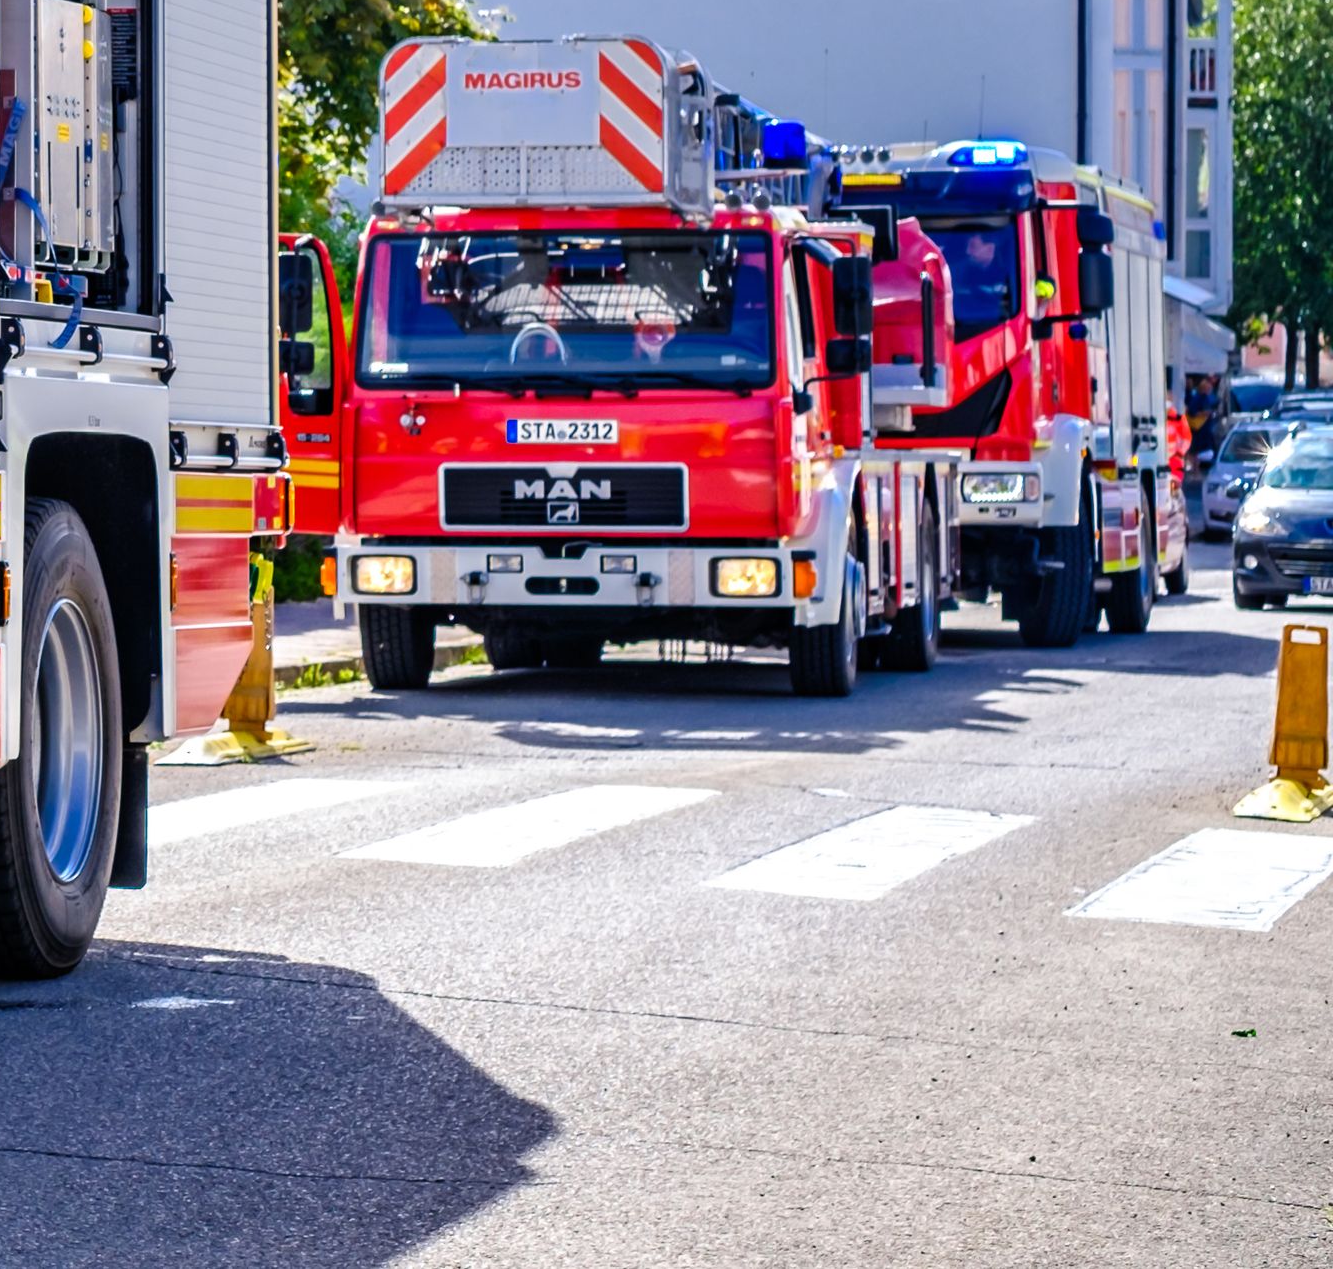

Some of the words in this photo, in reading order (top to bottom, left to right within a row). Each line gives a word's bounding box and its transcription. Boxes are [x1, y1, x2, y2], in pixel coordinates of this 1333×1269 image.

[464, 71, 581, 89] MAGIRUS
[521, 422, 556, 439] STA
[568, 422, 613, 440] 2312
[514, 479, 612, 499] MAN
